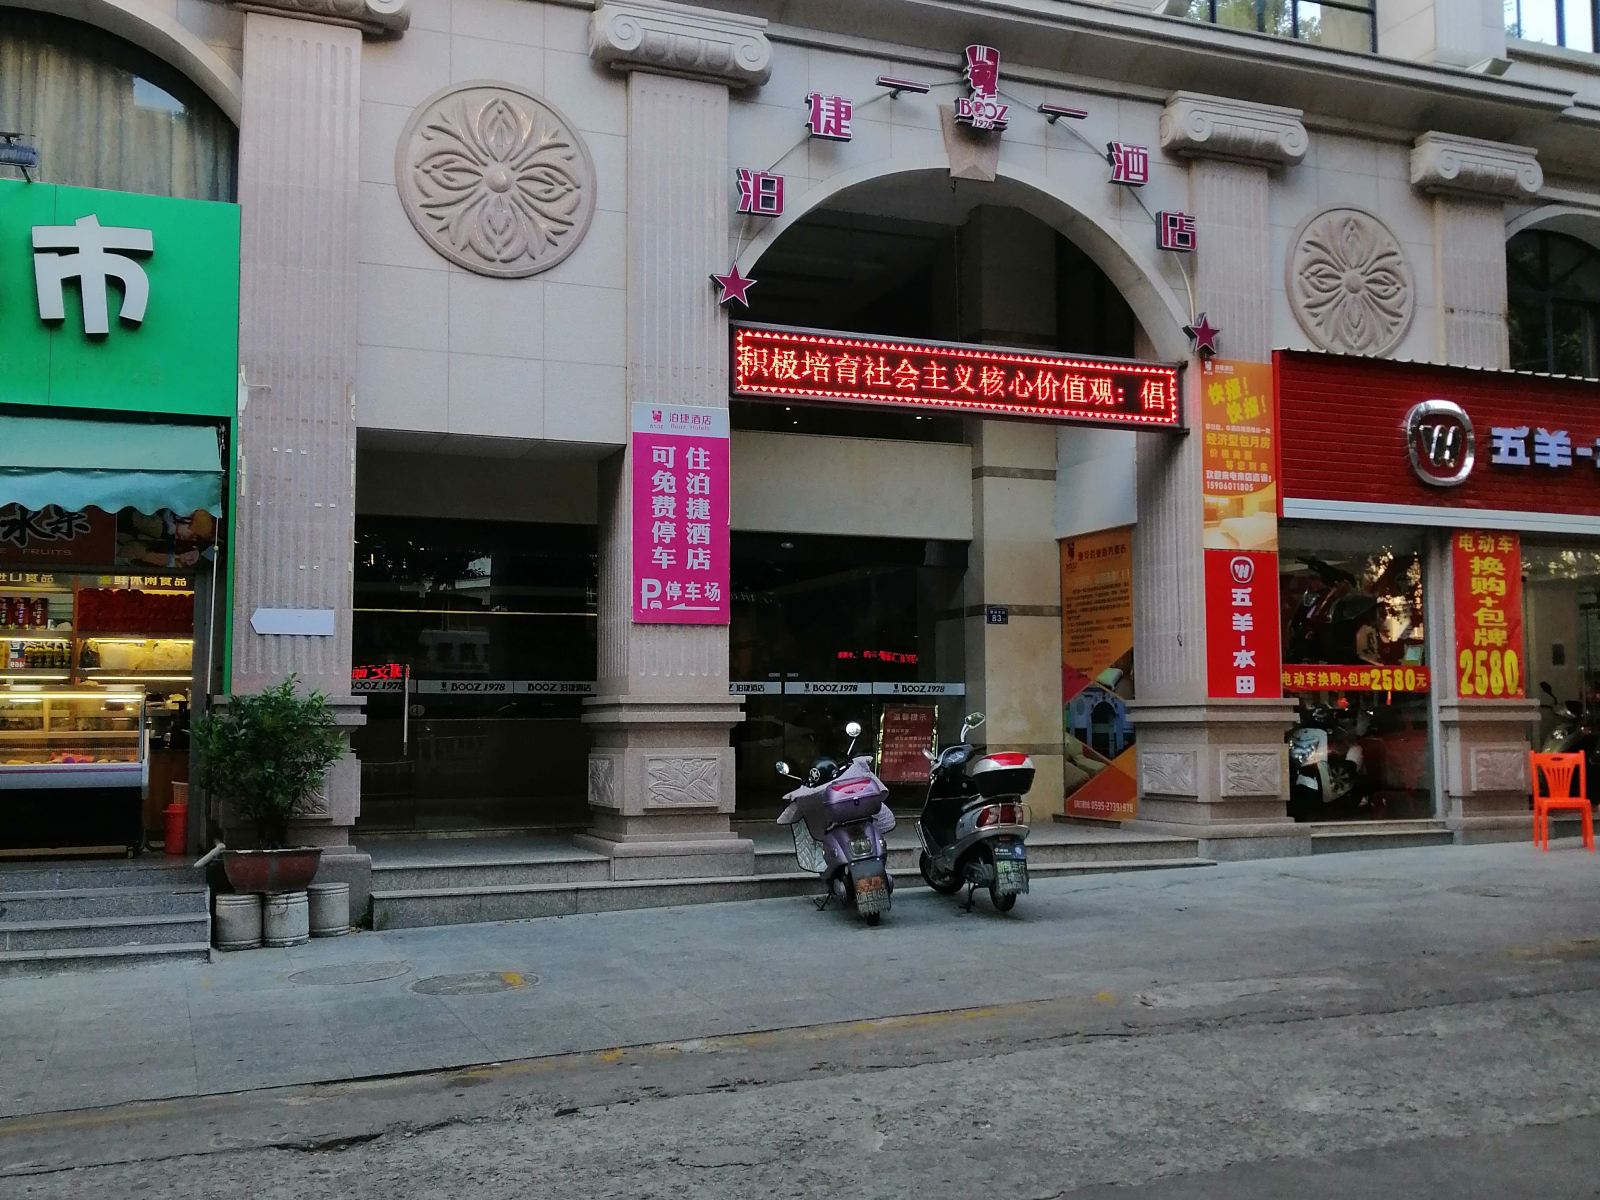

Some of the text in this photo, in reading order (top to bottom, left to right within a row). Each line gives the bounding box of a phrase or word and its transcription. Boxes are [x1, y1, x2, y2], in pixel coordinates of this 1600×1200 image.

[959, 98, 1009, 121] BOOZ
[974, 119, 994, 129] 1978
[31, 213, 154, 334] 市
[669, 412, 712, 426] 泊捷酒店
[1491, 425, 1600, 469] 五羊-
[651, 445, 677, 570] 可免费停车
[686, 447, 711, 570] 住泊捷酒店
[1459, 535, 1514, 553] 电动车
[666, 580, 721, 602] 停车场
[1470, 555, 1508, 647] 换购+包牌
[1232, 587, 1256, 694] 五羊-本田
[1459, 649, 1519, 695] 2580
[451, 682, 506, 692] BOOZ 1978
[527, 682, 557, 692] BOOZ
[812, 684, 858, 693] BOOZ 1978
[901, 684, 945, 693] BOOZ 1978
